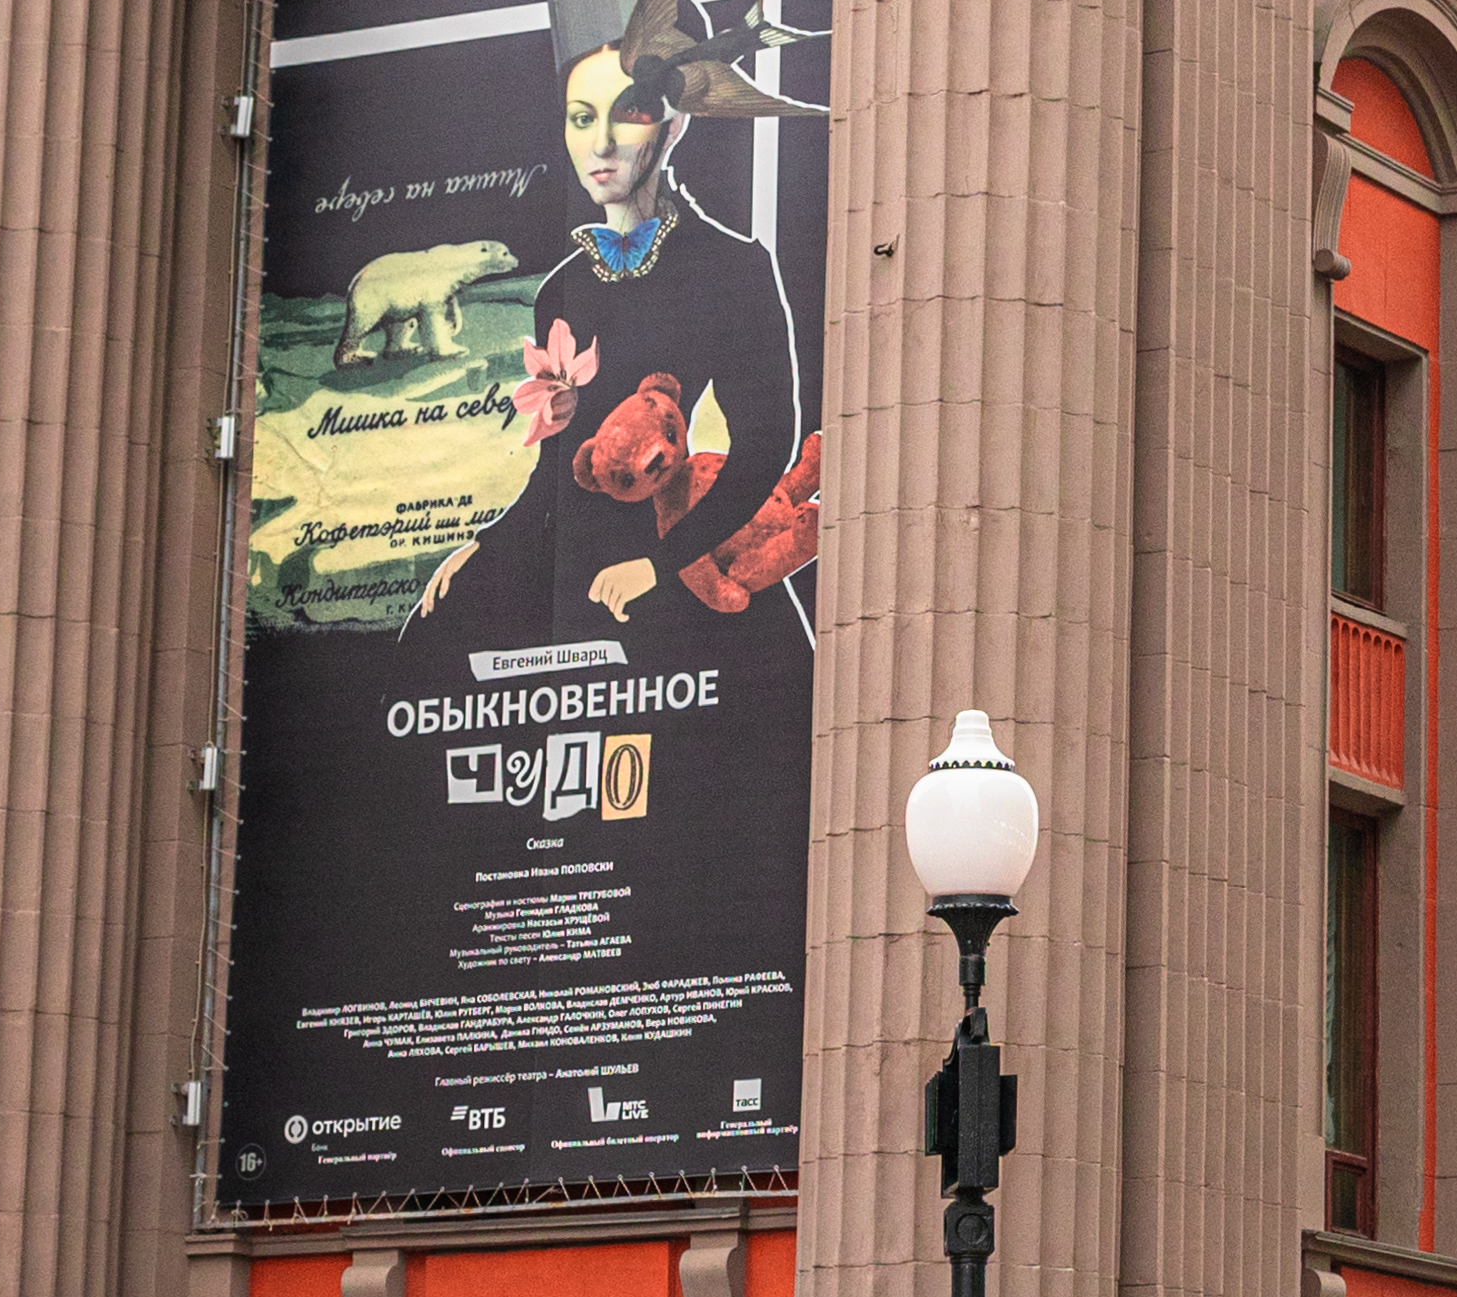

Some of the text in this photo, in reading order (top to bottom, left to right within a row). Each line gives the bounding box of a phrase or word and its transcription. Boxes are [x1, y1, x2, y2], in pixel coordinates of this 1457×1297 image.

[405, 181, 434, 199] на
[445, 164, 546, 197] Мишка
[307, 406, 406, 438] Мишка
[414, 404, 447, 424] на
[396, 494, 472, 514] ФАБРИКА ДЕ
[274, 569, 429, 613] Кондитерско
[492, 649, 608, 670] Евгений Шварц
[388, 670, 717, 735] ОБЫКНОВЕННОЕ
[448, 740, 645, 812] ЧУДО
[526, 837, 564, 849] Сказка
[475, 861, 613, 881] Постановка Ивана ПОПОВСКИ
[554, 902, 598, 913] ГЛАДКОВА
[599, 935, 631, 945] АГАЕВА
[517, 1071, 547, 1081] театра
[600, 1063, 638, 1075] ШУЛЬЕВ
[621, 1108, 648, 1119] LIVE
[622, 1099, 646, 1111] МТС
[468, 1107, 505, 1129] ВТБ
[239, 1152, 262, 1171] 16+
